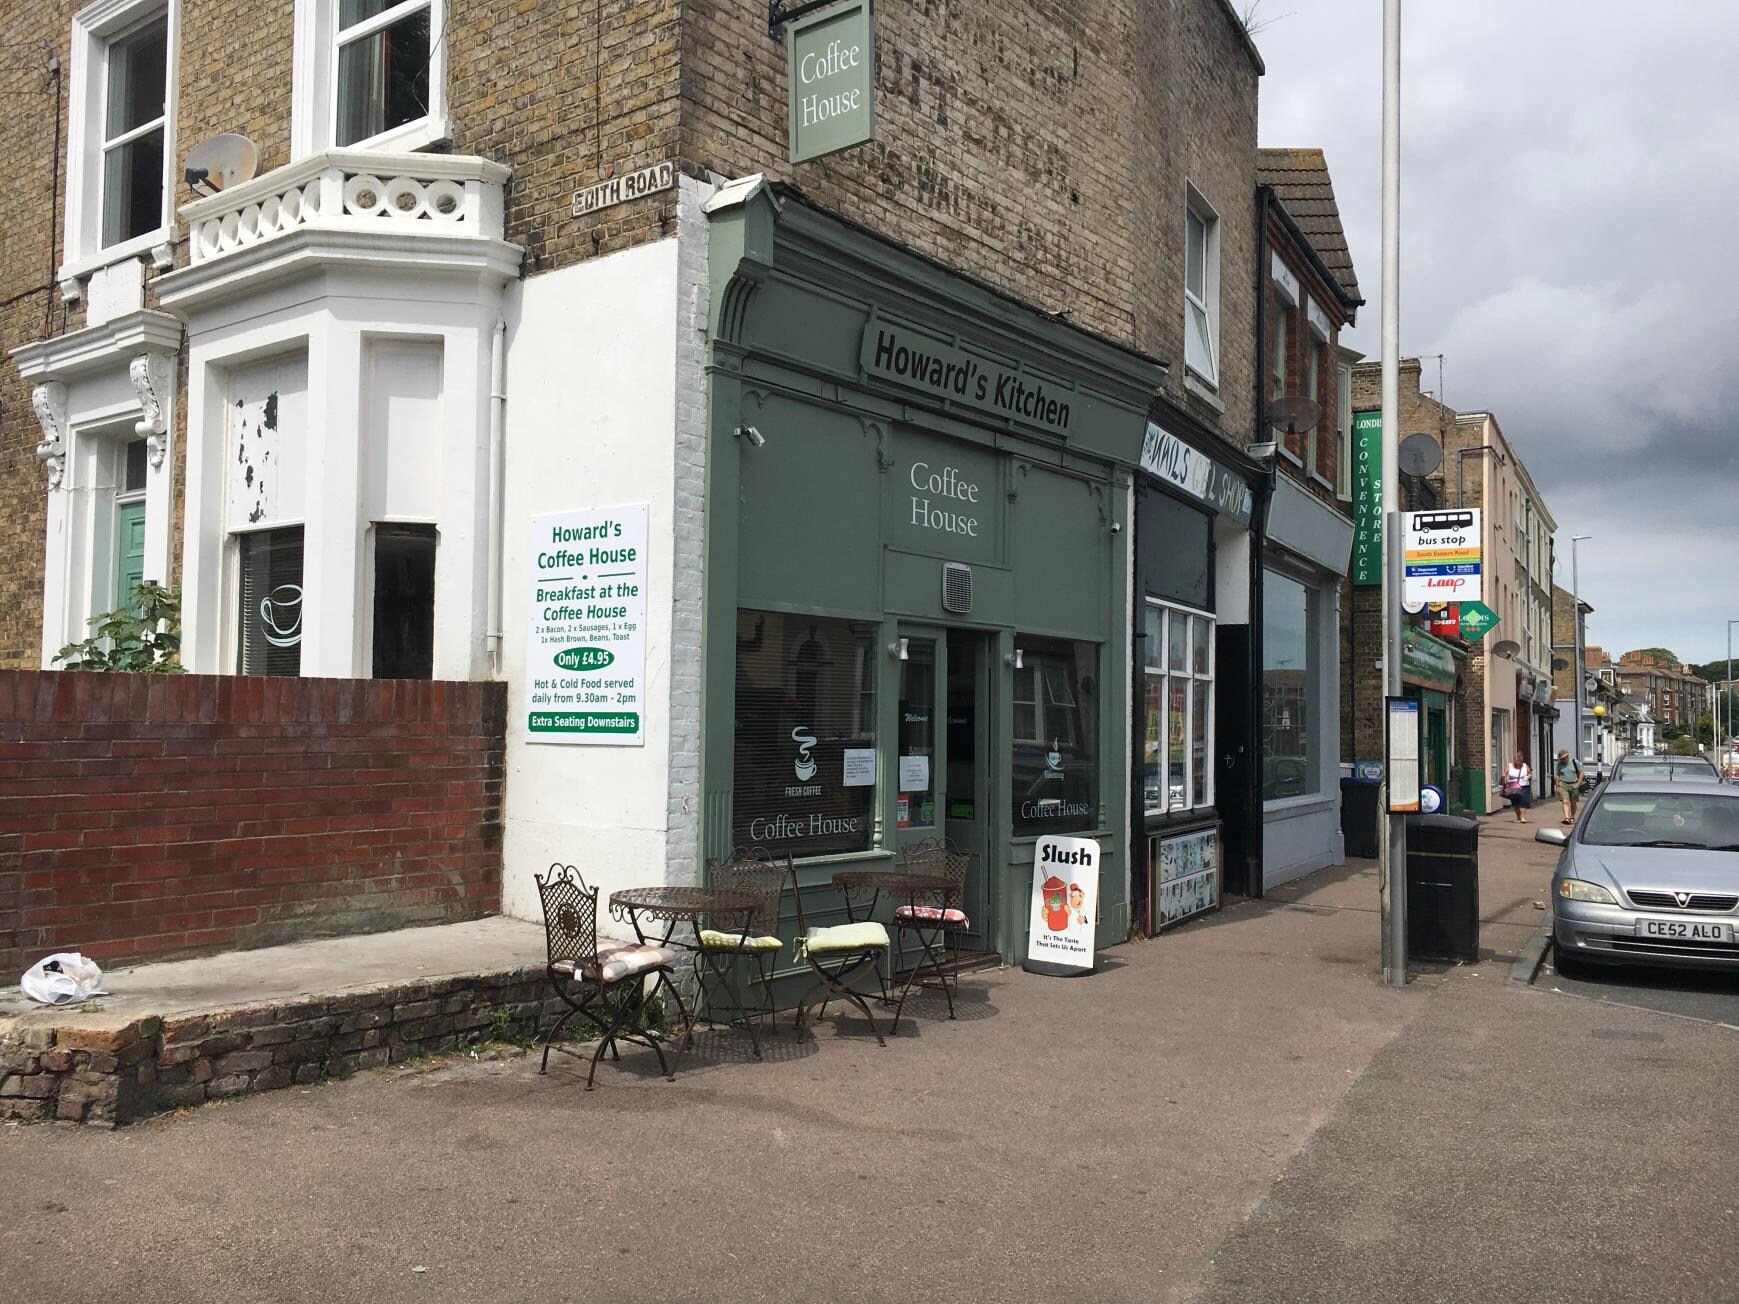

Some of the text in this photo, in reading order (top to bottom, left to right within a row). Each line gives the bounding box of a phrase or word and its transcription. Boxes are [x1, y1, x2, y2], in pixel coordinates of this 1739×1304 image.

[801, 40, 860, 84] Coffee
[802, 88, 860, 127] House
[574, 164, 671, 213] EDITH ROAD
[875, 330, 1070, 429] Howard's Kitchen
[910, 462, 978, 503] Coffee
[910, 496, 978, 537] House
[1358, 438, 1368, 580] CONVENIENCE
[1373, 479, 1382, 543] STORE
[552, 520, 622, 543] Howard's
[1418, 535, 1466, 546] bus stop
[537, 547, 637, 569] Coffee House
[536, 582, 639, 602] Breakfast at the
[543, 604, 627, 621] Coffee House
[535, 626, 540, 634] 2
[612, 622, 617, 630] 1
[624, 622, 637, 631] Egg
[549, 635, 565, 644] Hash
[589, 633, 611, 642] Beans,
[613, 633, 630, 641] Toast
[558, 651, 610, 668] Only £4.95
[534, 677, 634, 689] Hot & Cold Food served
[532, 693, 552, 706] daily
[554, 693, 574, 703] from
[576, 692, 608, 703] 9.30am
[616, 692, 636, 706] 2pm
[532, 715, 636, 730] Extra Seating Downstairs
[904, 712, 929, 722] Welcome
[785, 785, 822, 796] FRESH COFFEE
[1021, 799, 1089, 819] Coffee House
[750, 813, 857, 840] Coffee House
[1041, 843, 1092, 866] Slush
[1647, 922, 1687, 937] CE52
[1036, 940, 1049, 948] That
[1070, 945, 1087, 953] Apart
